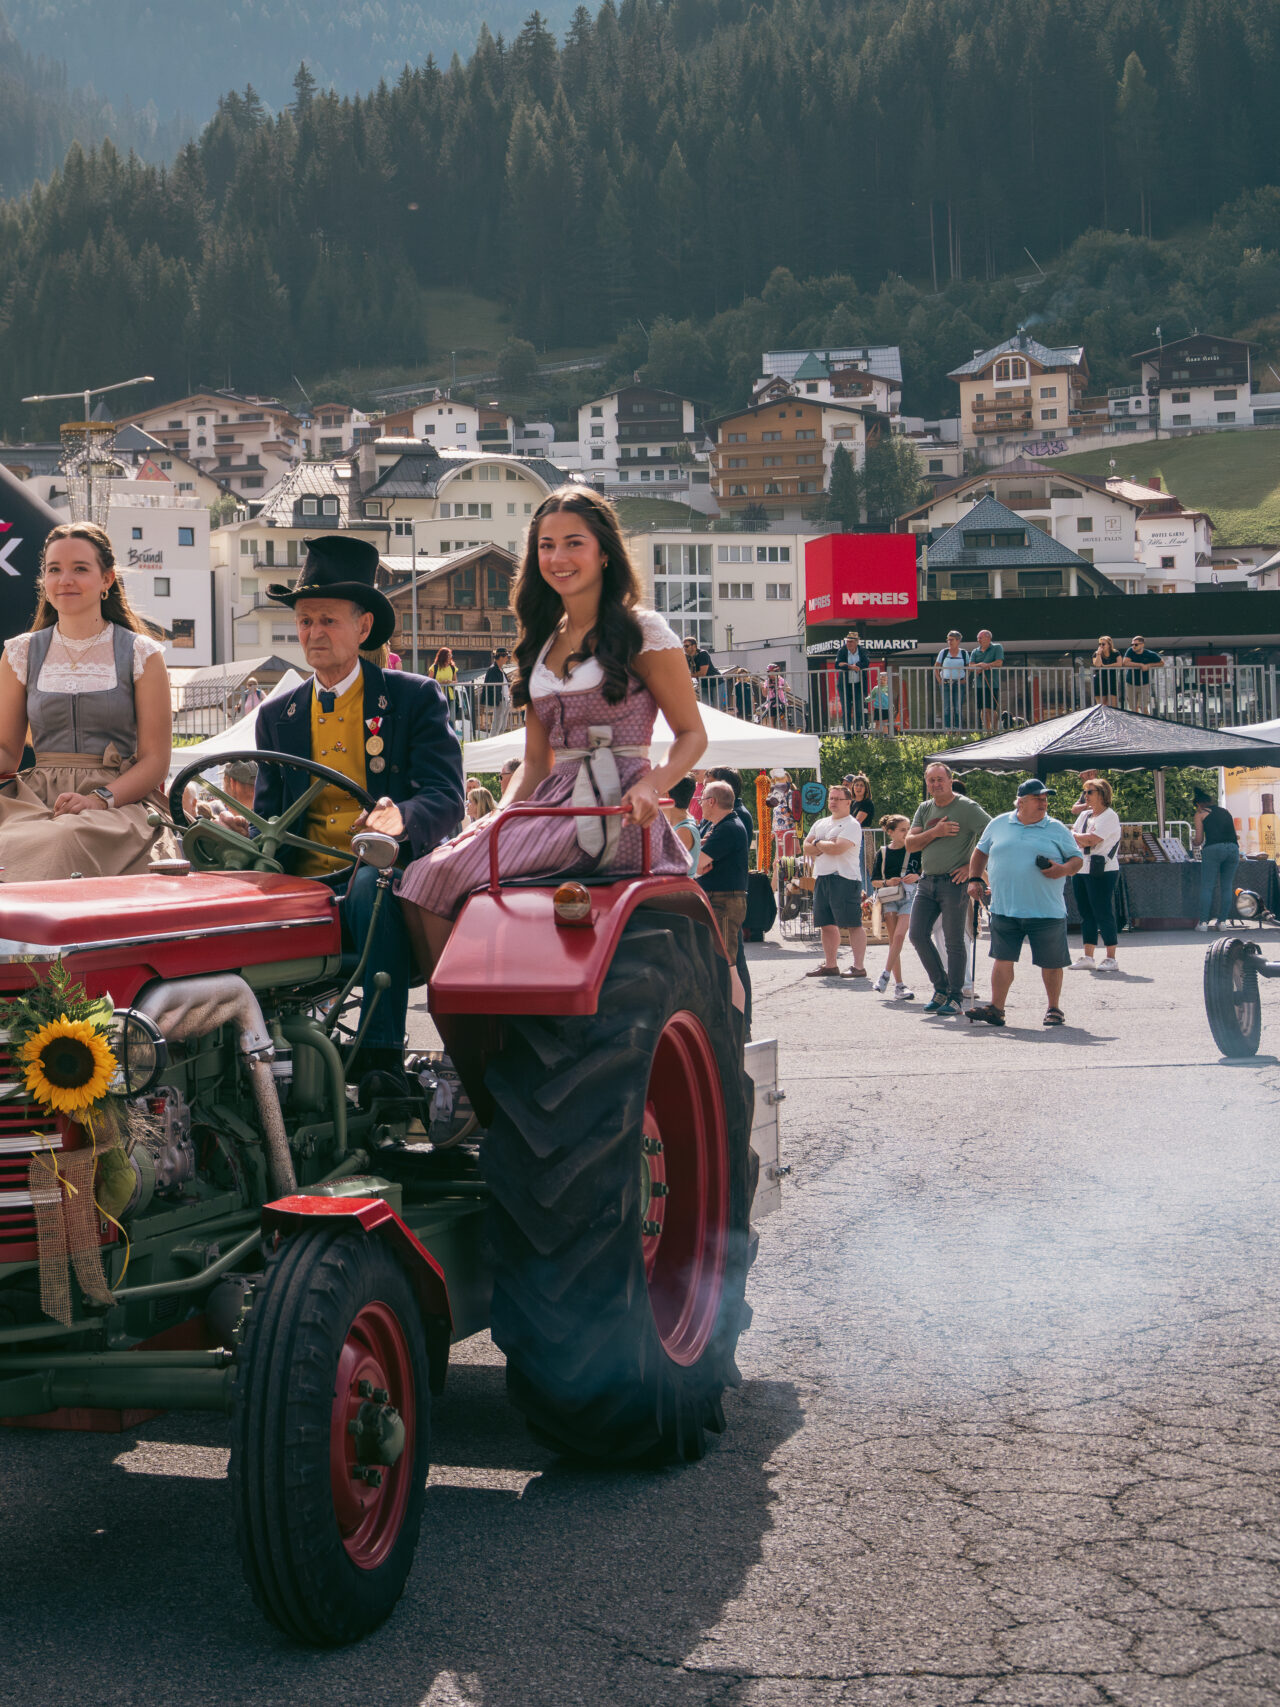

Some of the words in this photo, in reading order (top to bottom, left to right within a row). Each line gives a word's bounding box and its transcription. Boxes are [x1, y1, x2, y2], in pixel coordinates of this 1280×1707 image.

[809, 593, 832, 612] MPREIS
[842, 592, 910, 605] MPREIS
[806, 639, 834, 655] SUPERMARKT
